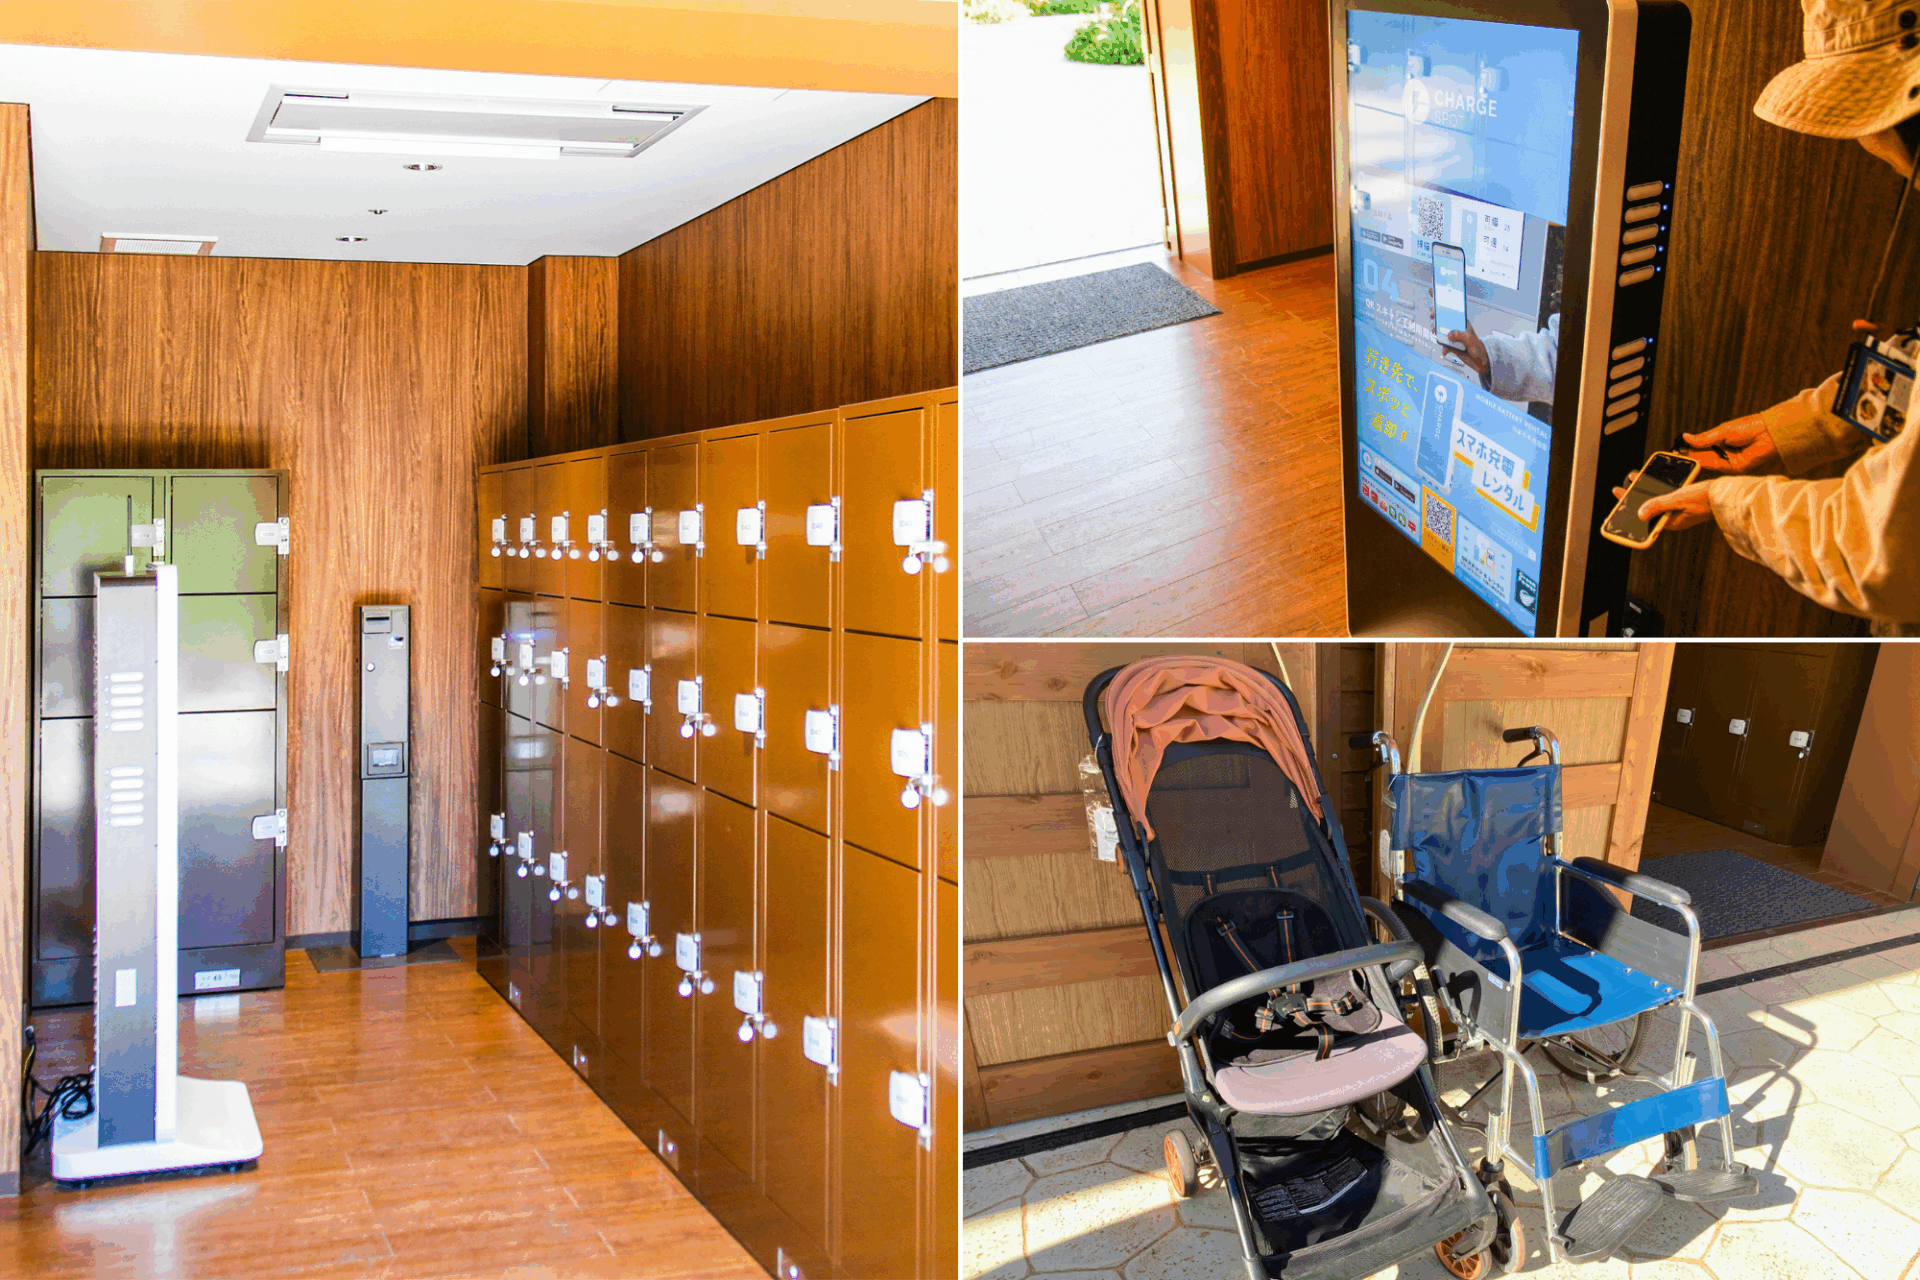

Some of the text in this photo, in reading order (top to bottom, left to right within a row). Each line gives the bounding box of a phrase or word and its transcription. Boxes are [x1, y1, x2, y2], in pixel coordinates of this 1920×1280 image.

[1434, 89, 1497, 118] CHARGE
[1362, 257, 1400, 303] 04
[1366, 347, 1418, 393] 行き先で、
[1434, 404, 1444, 440] CHARGE
[1475, 393, 1497, 410] MOBILE
[1456, 427, 1516, 479] スマホ充電
[1482, 470, 1525, 512] レンタル
